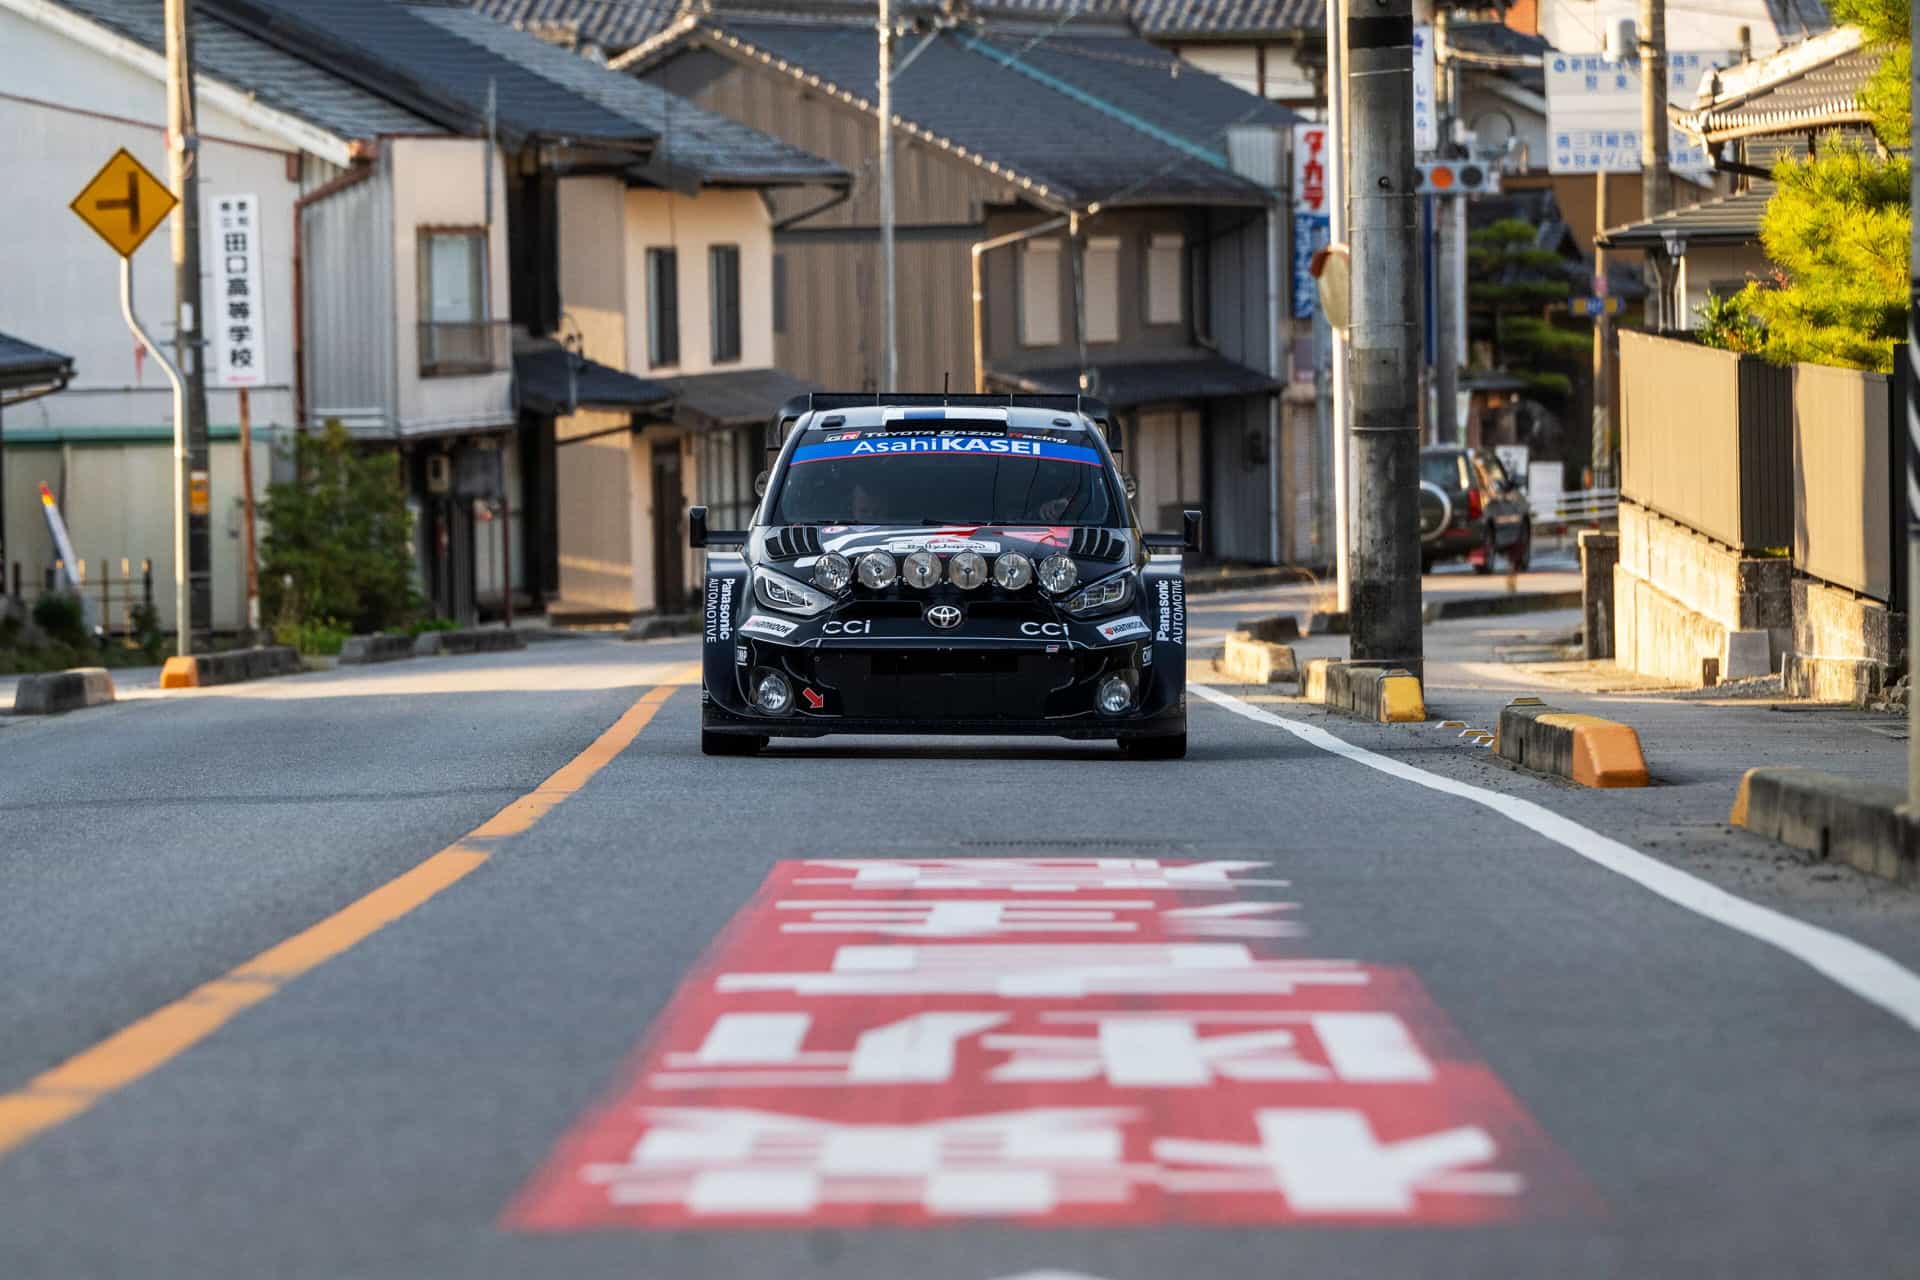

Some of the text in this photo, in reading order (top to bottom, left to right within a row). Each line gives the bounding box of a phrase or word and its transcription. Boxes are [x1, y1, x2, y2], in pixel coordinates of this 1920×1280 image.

[1302, 129, 1325, 210] タカラ
[223, 231, 254, 368] 田口高等学校
[864, 430, 934, 438] TOYOTA
[1008, 432, 1068, 444] Racing
[706, 578, 720, 644] AUTOMOTIVE
[720, 578, 736, 640] Panasonic
[1155, 579, 1169, 642] Panasonic
[1171, 578, 1183, 645] AUTOMOTIVE
